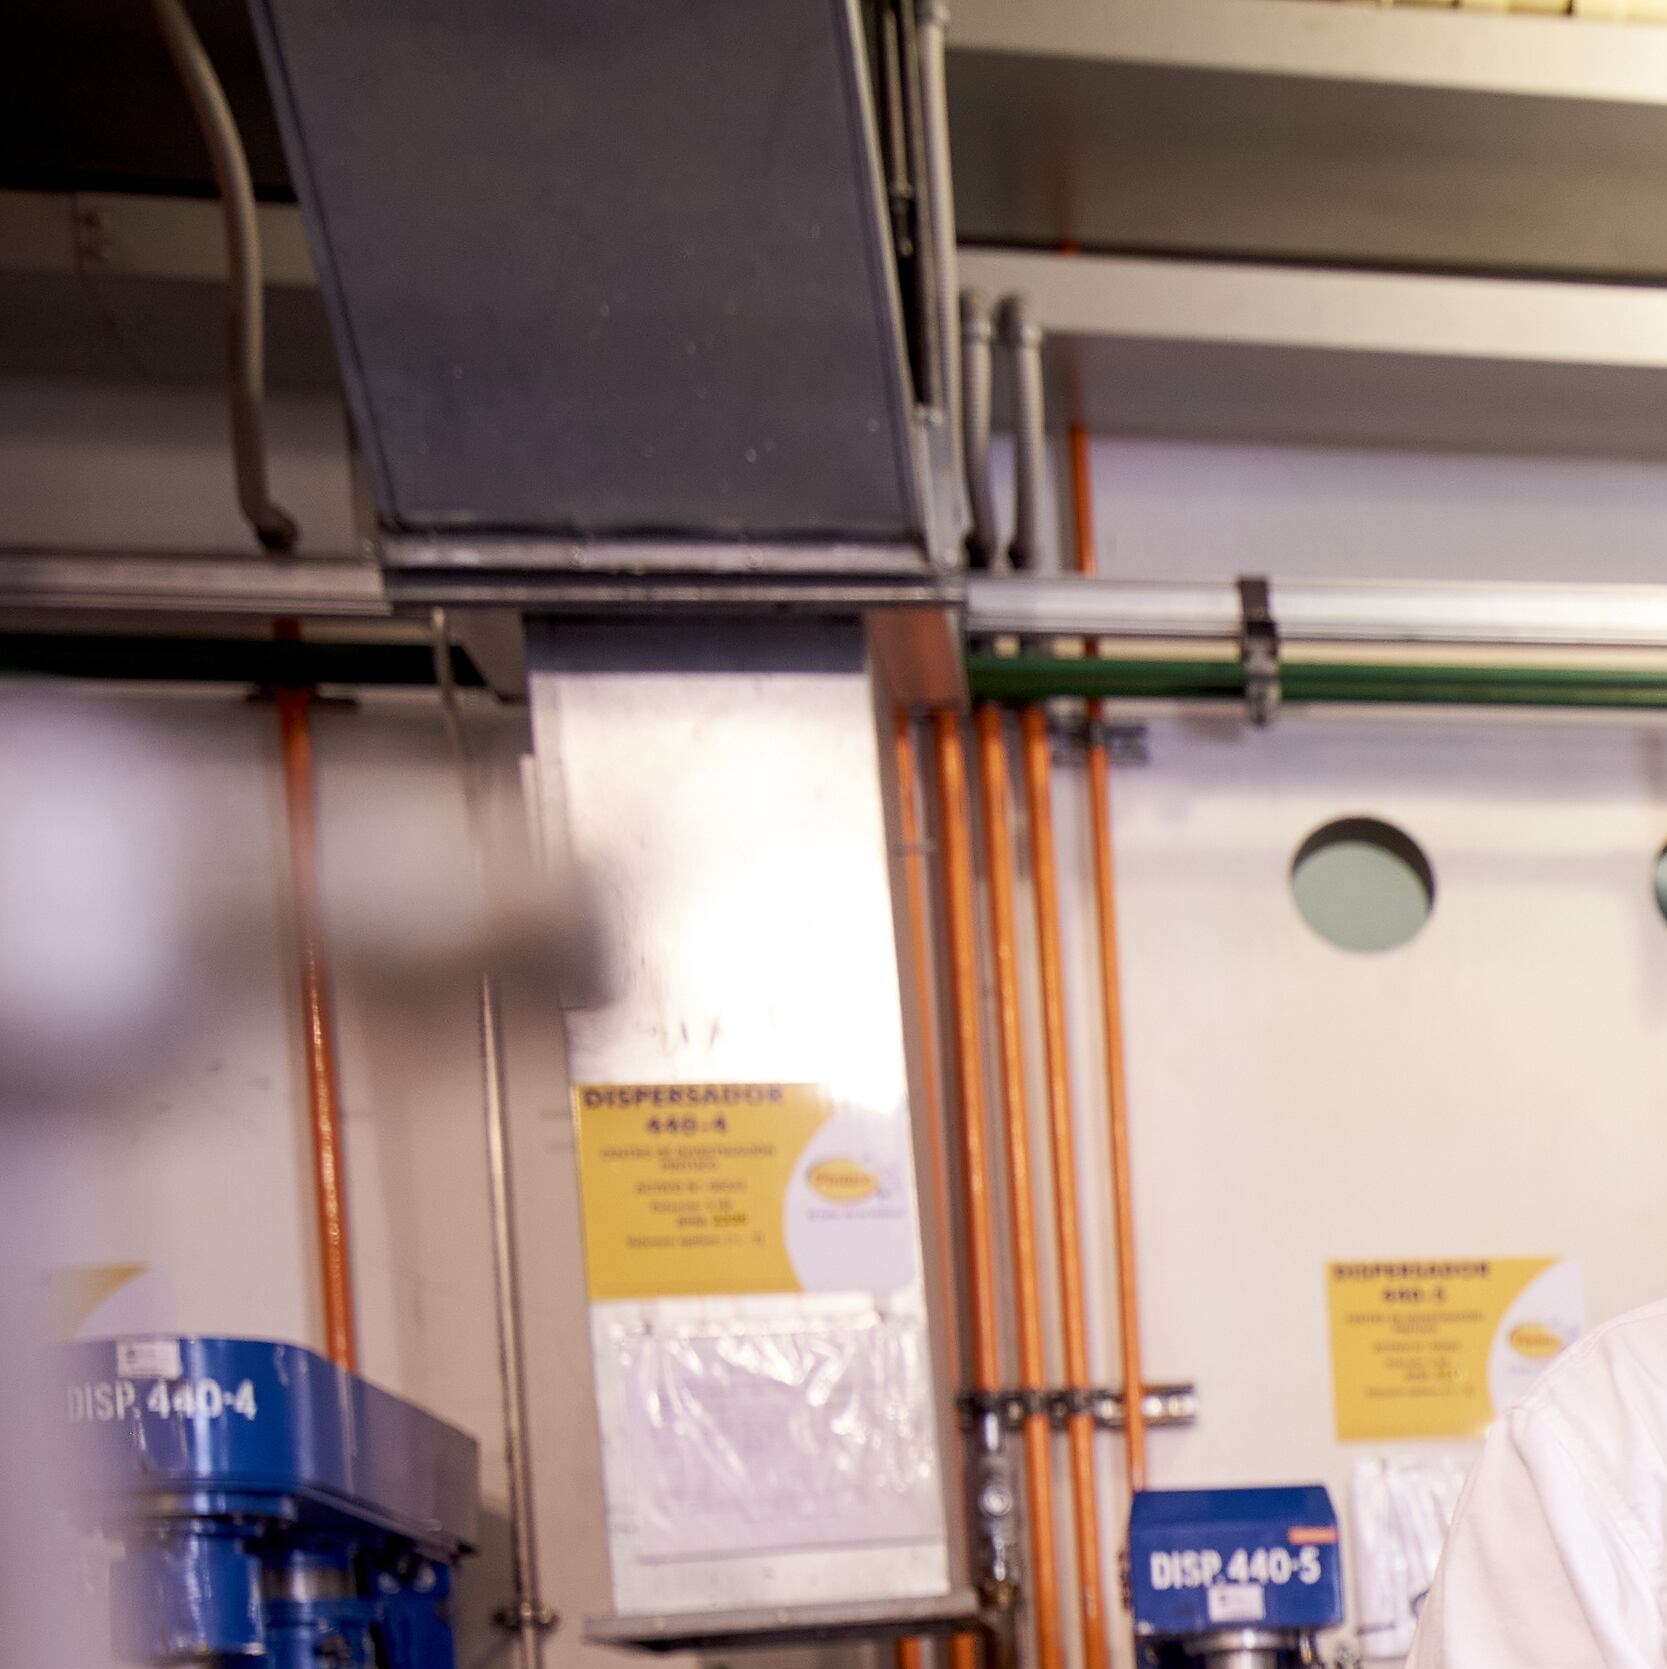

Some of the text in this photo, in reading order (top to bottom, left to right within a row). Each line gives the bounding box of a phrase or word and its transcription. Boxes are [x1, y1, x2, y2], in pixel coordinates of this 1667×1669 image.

[583, 1085, 783, 1109] DISPERSADOR
[647, 1113, 726, 1133] 440-4
[147, 1376, 257, 1421] 440-4
[1227, 1546, 1321, 1585] 440-5
